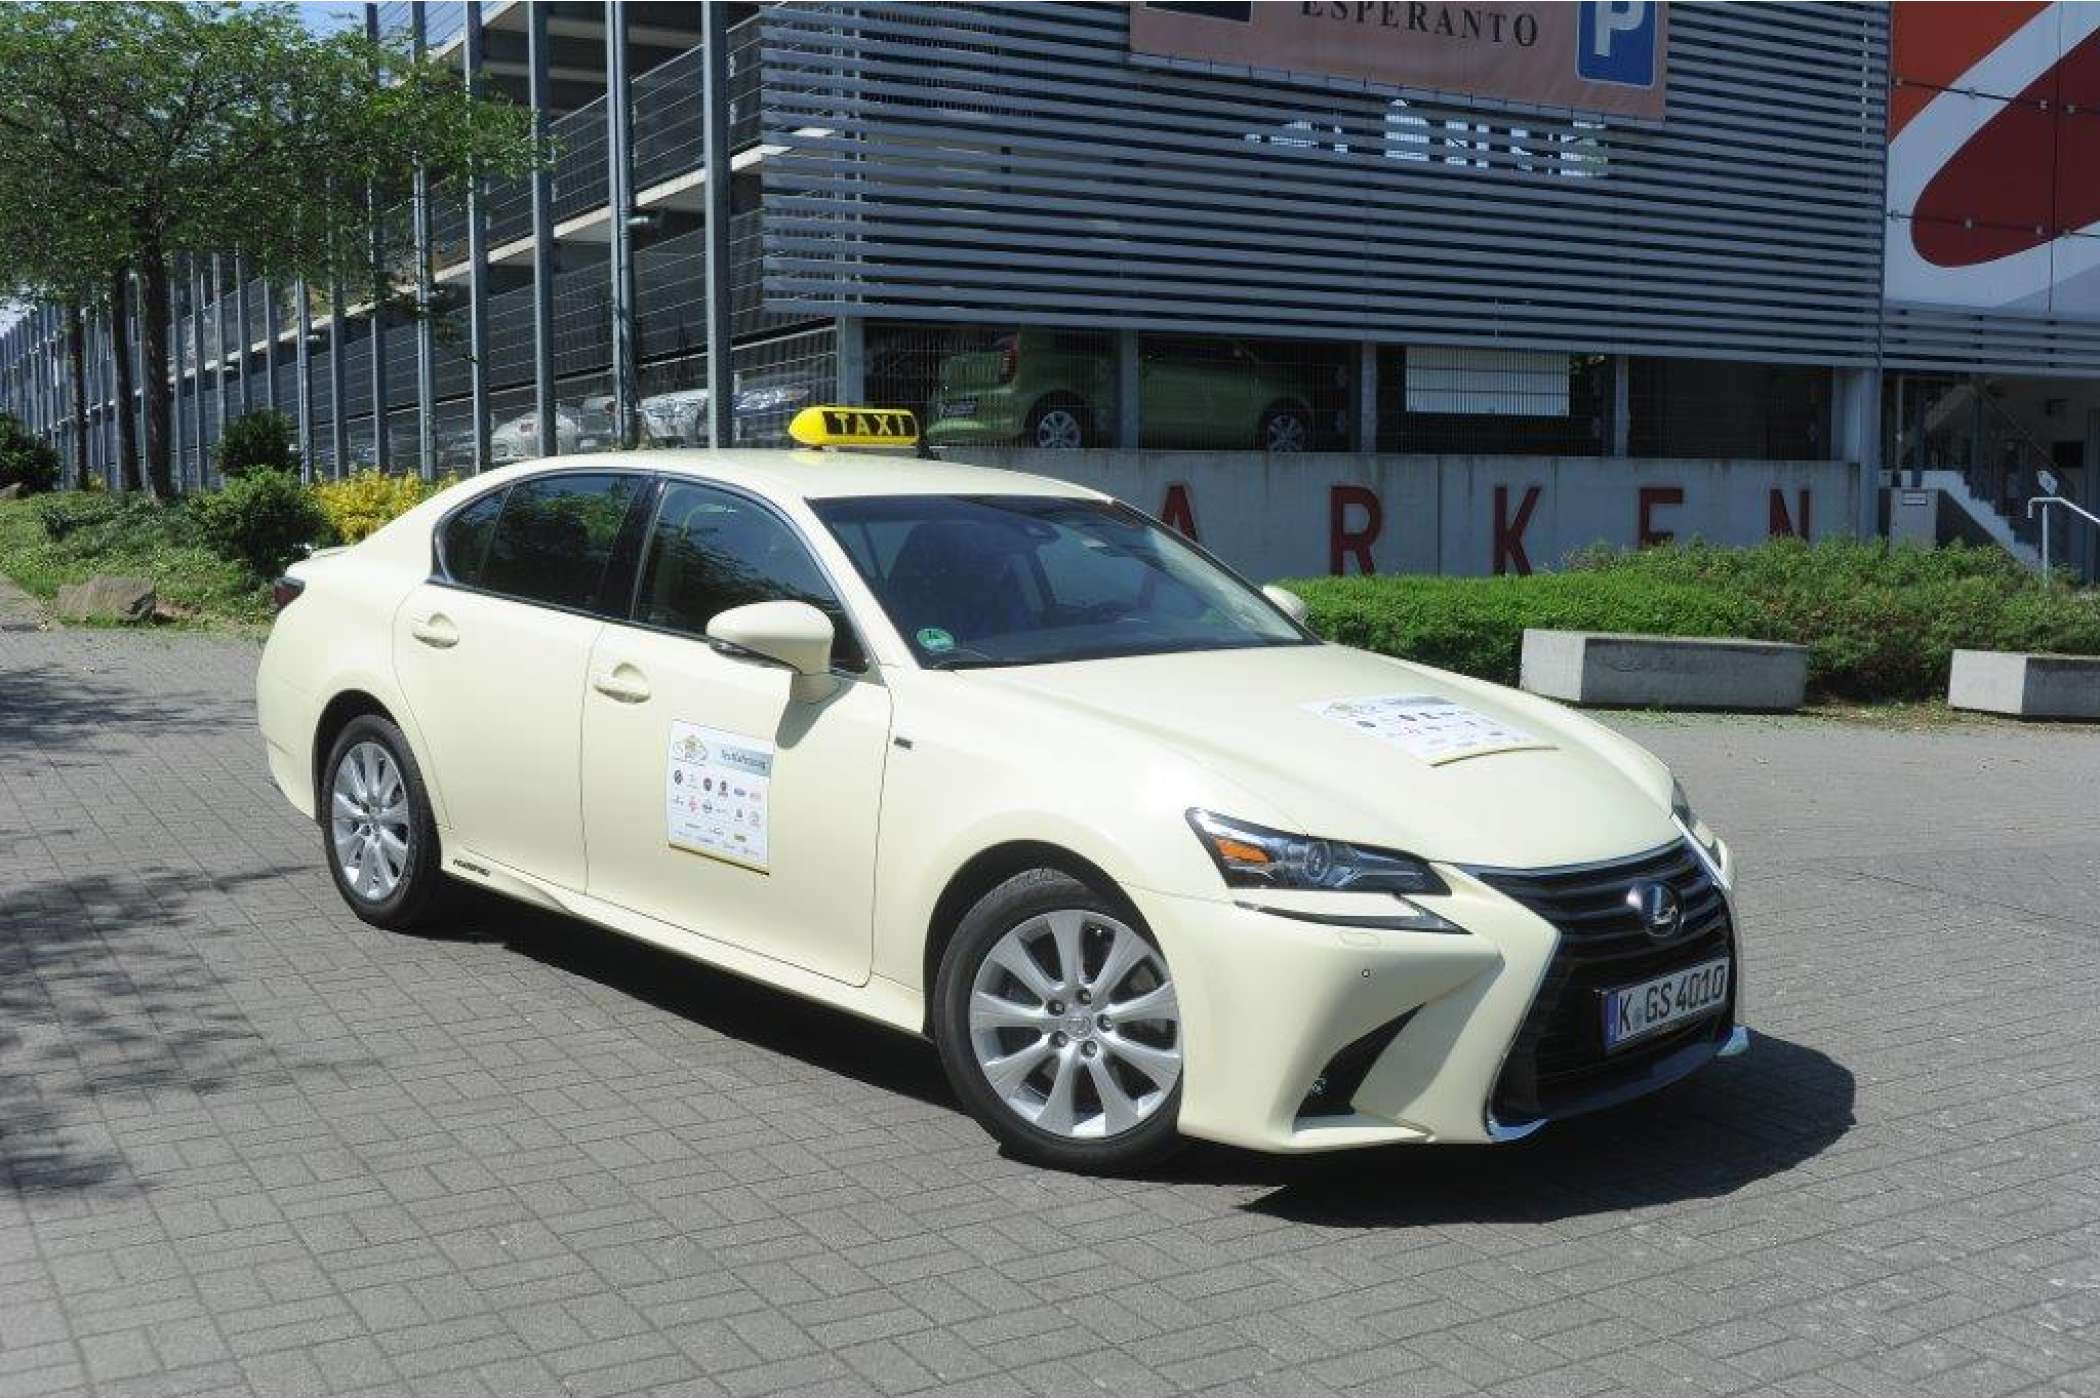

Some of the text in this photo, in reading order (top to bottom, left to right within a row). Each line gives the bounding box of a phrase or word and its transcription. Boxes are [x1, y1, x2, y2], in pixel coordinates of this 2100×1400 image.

[1303, 1, 1538, 47] ESPERANTO
[834, 412, 905, 437] TAXI
[1619, 964, 1725, 1035] K GS 4010
